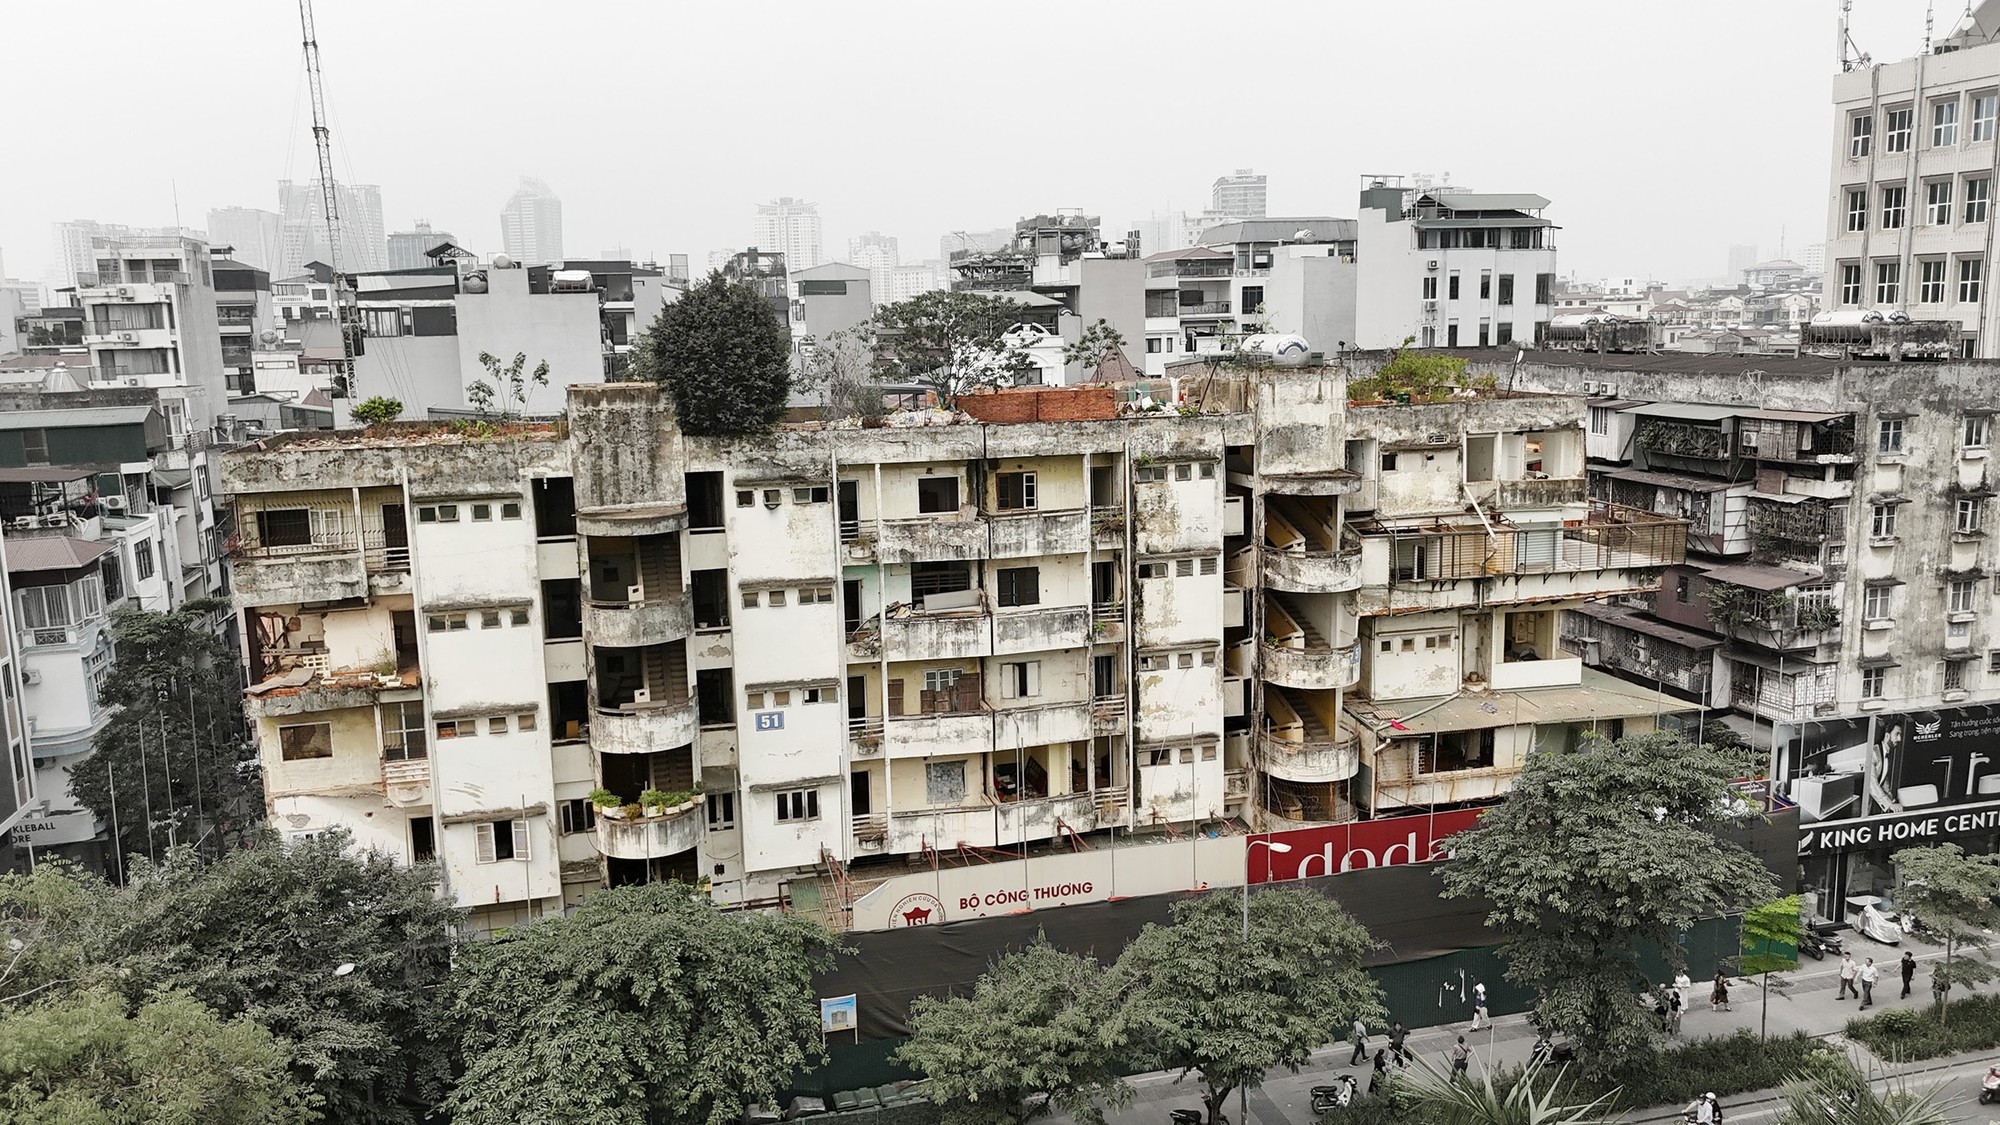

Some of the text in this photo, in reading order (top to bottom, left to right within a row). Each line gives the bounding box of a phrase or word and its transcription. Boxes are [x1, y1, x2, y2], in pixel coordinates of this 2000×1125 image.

[761, 714, 779, 728] 51
[1820, 826, 1872, 849] KING
[1878, 818, 1939, 842] HOME
[959, 882, 1093, 911] BỘ CÔNG THƯƠNG
